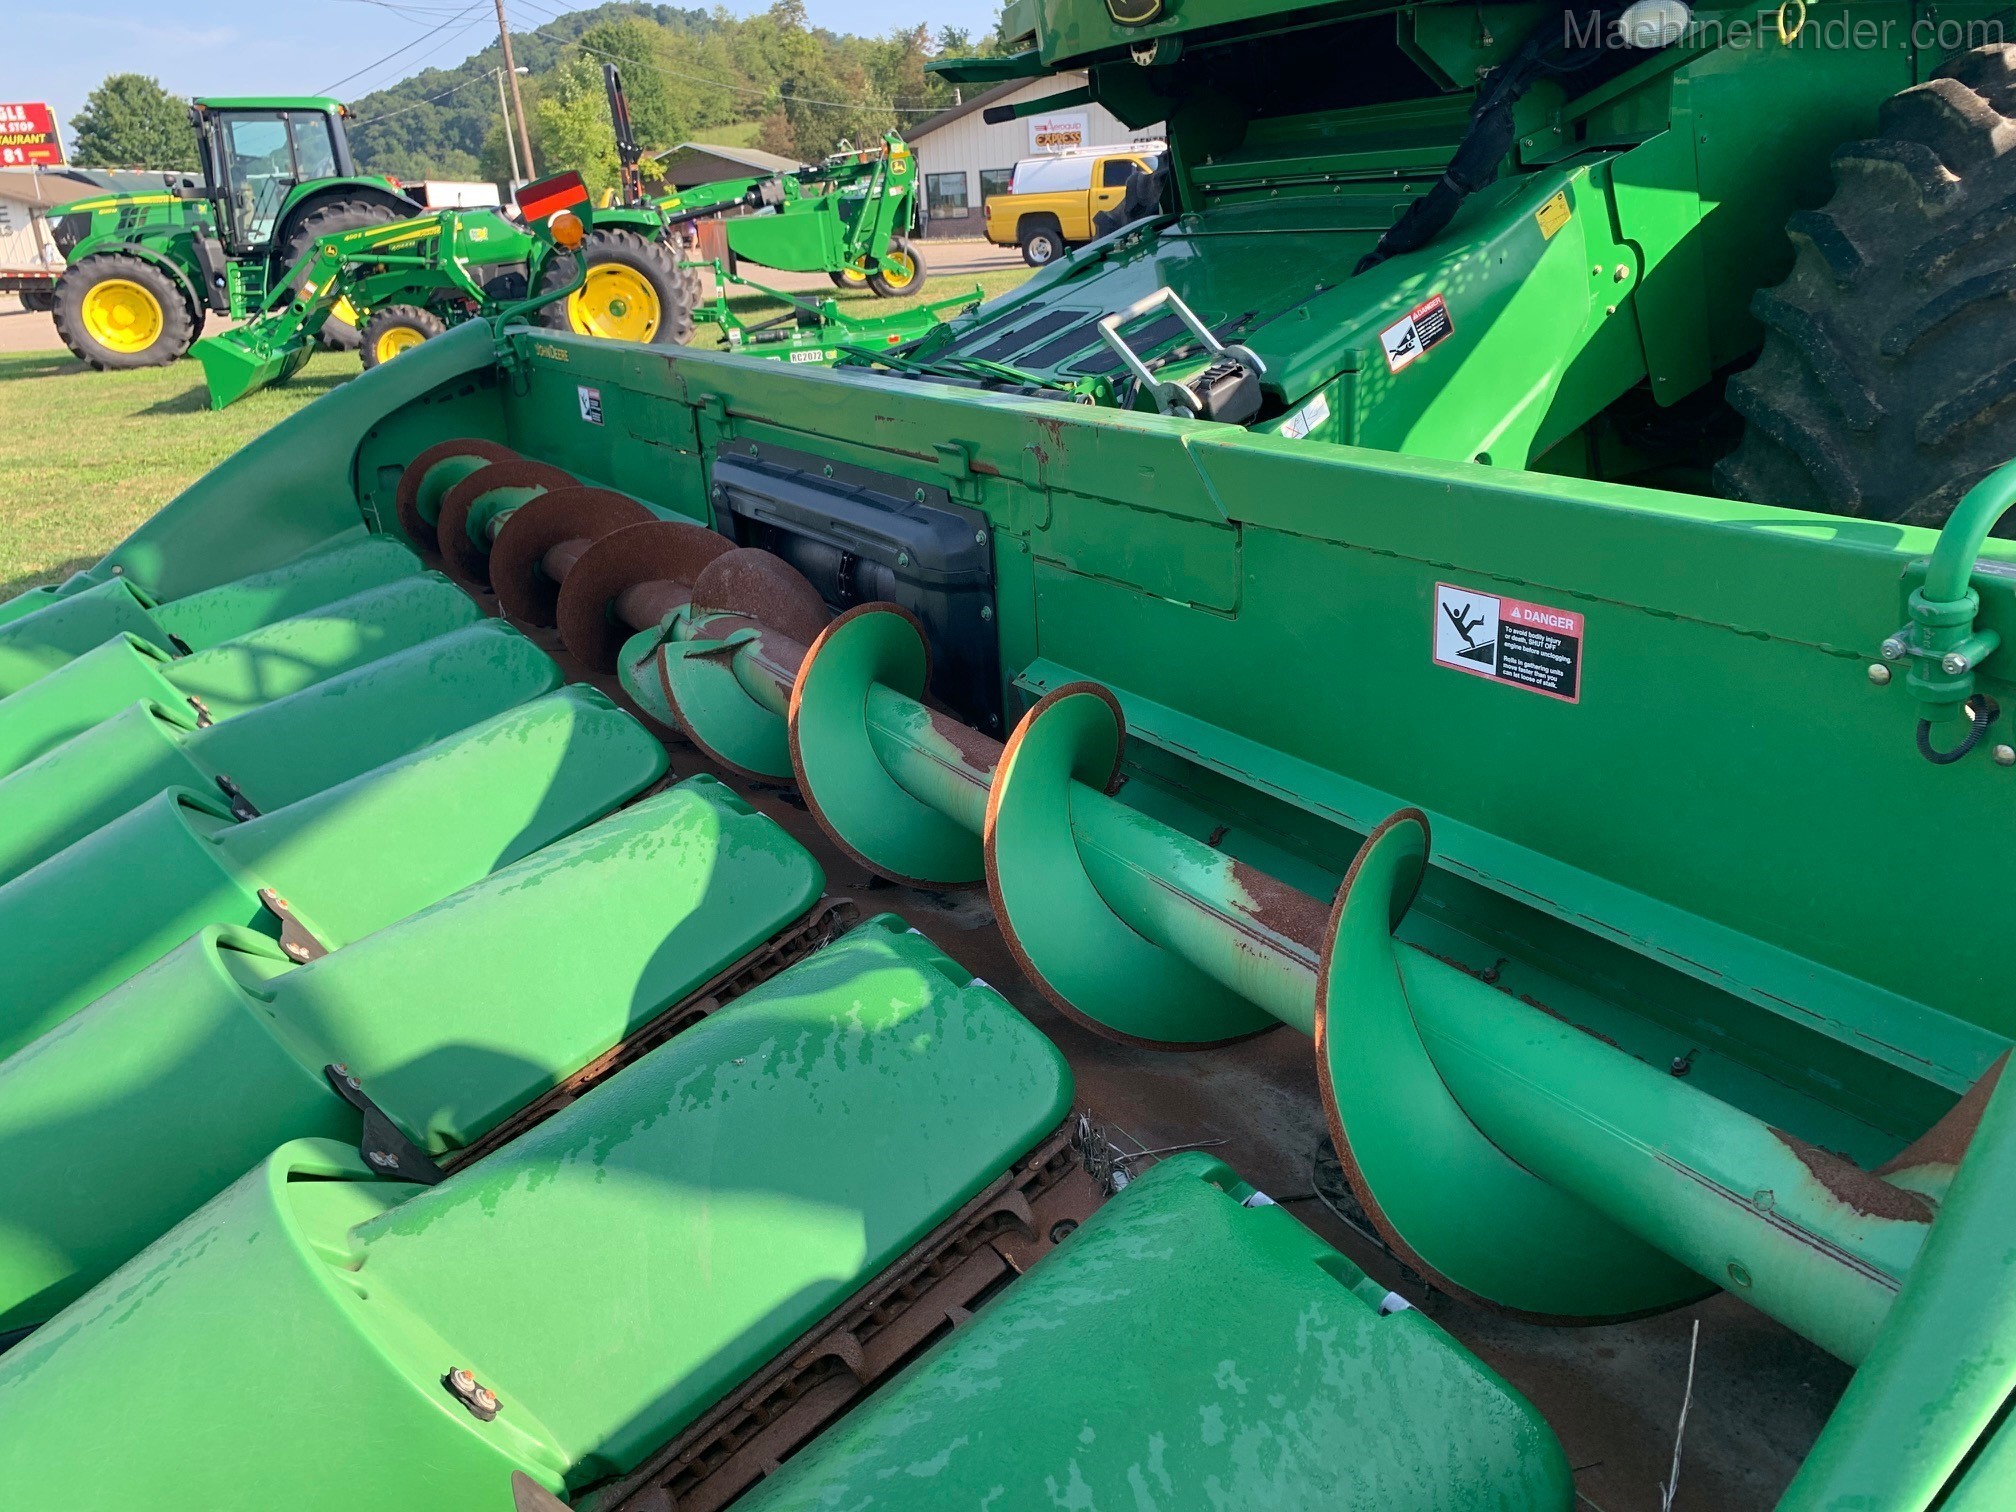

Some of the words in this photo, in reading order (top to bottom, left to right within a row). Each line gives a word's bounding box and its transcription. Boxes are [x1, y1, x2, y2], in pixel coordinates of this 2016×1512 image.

[8, 121, 34, 132] STOP
[1047, 119, 1081, 131] Aeroquip
[1036, 131, 1082, 147] EXPRESS
[3, 148, 25, 163] 81
[1418, 297, 1441, 314] DANGER
[792, 352, 821, 361] RC2072
[1524, 609, 1574, 631] DANGER
[1511, 635, 1528, 645] death,
[1528, 638, 1544, 648] SHUT
[1545, 643, 1557, 651] OFF
[1513, 628, 1528, 637] avoid
[1528, 631, 1545, 642] bodily
[1546, 636, 1562, 647] injury
[1504, 642, 1521, 650] engine
[1522, 646, 1540, 655] before
[1540, 651, 1572, 664] unclogging.
[1503, 655, 1517, 664] Rolls
[1523, 661, 1549, 674] gathering
[1550, 668, 1564, 677] units
[1518, 666, 1534, 675] faster
[1533, 670, 1546, 679] than
[1547, 674, 1558, 682] you
[1520, 673, 1536, 683] loose
